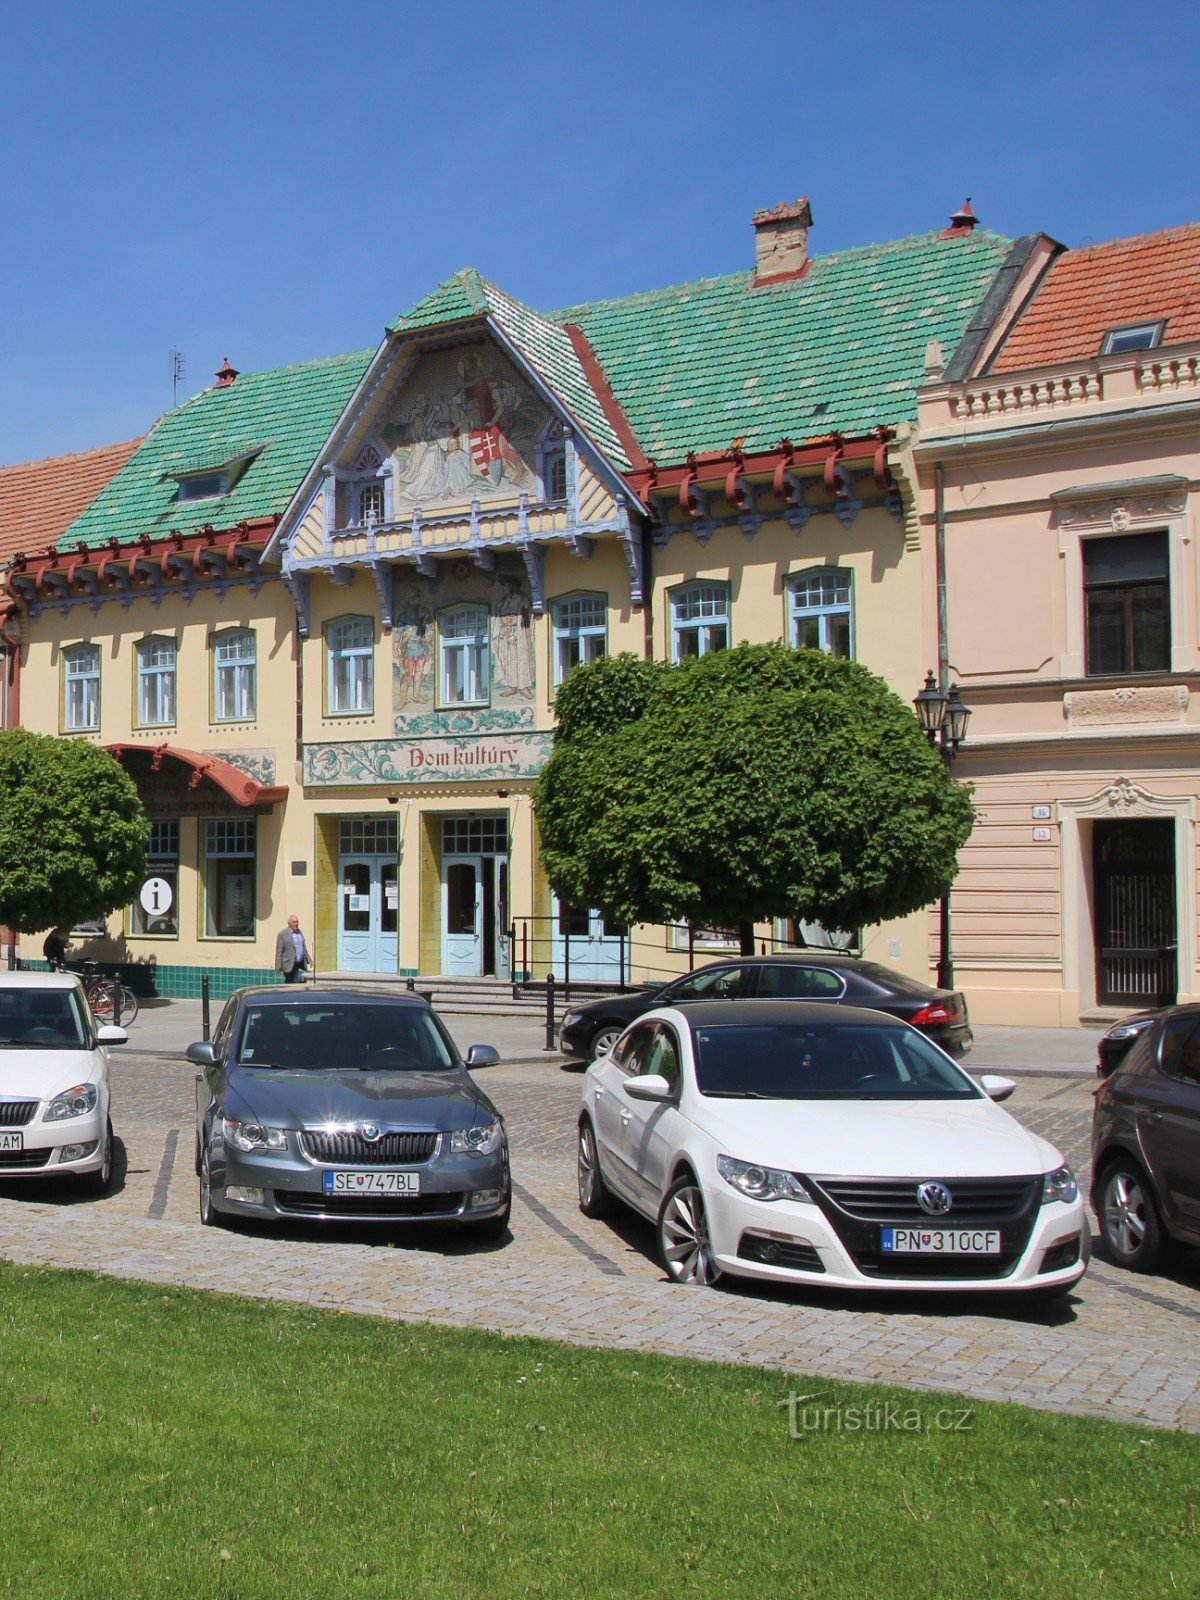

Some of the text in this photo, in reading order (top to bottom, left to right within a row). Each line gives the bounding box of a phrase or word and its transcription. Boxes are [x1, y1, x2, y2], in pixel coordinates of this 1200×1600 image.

[409, 746, 518, 769] Dom kultúry
[365, 1174, 417, 1190] 747BL
[895, 1230, 921, 1250] PN
